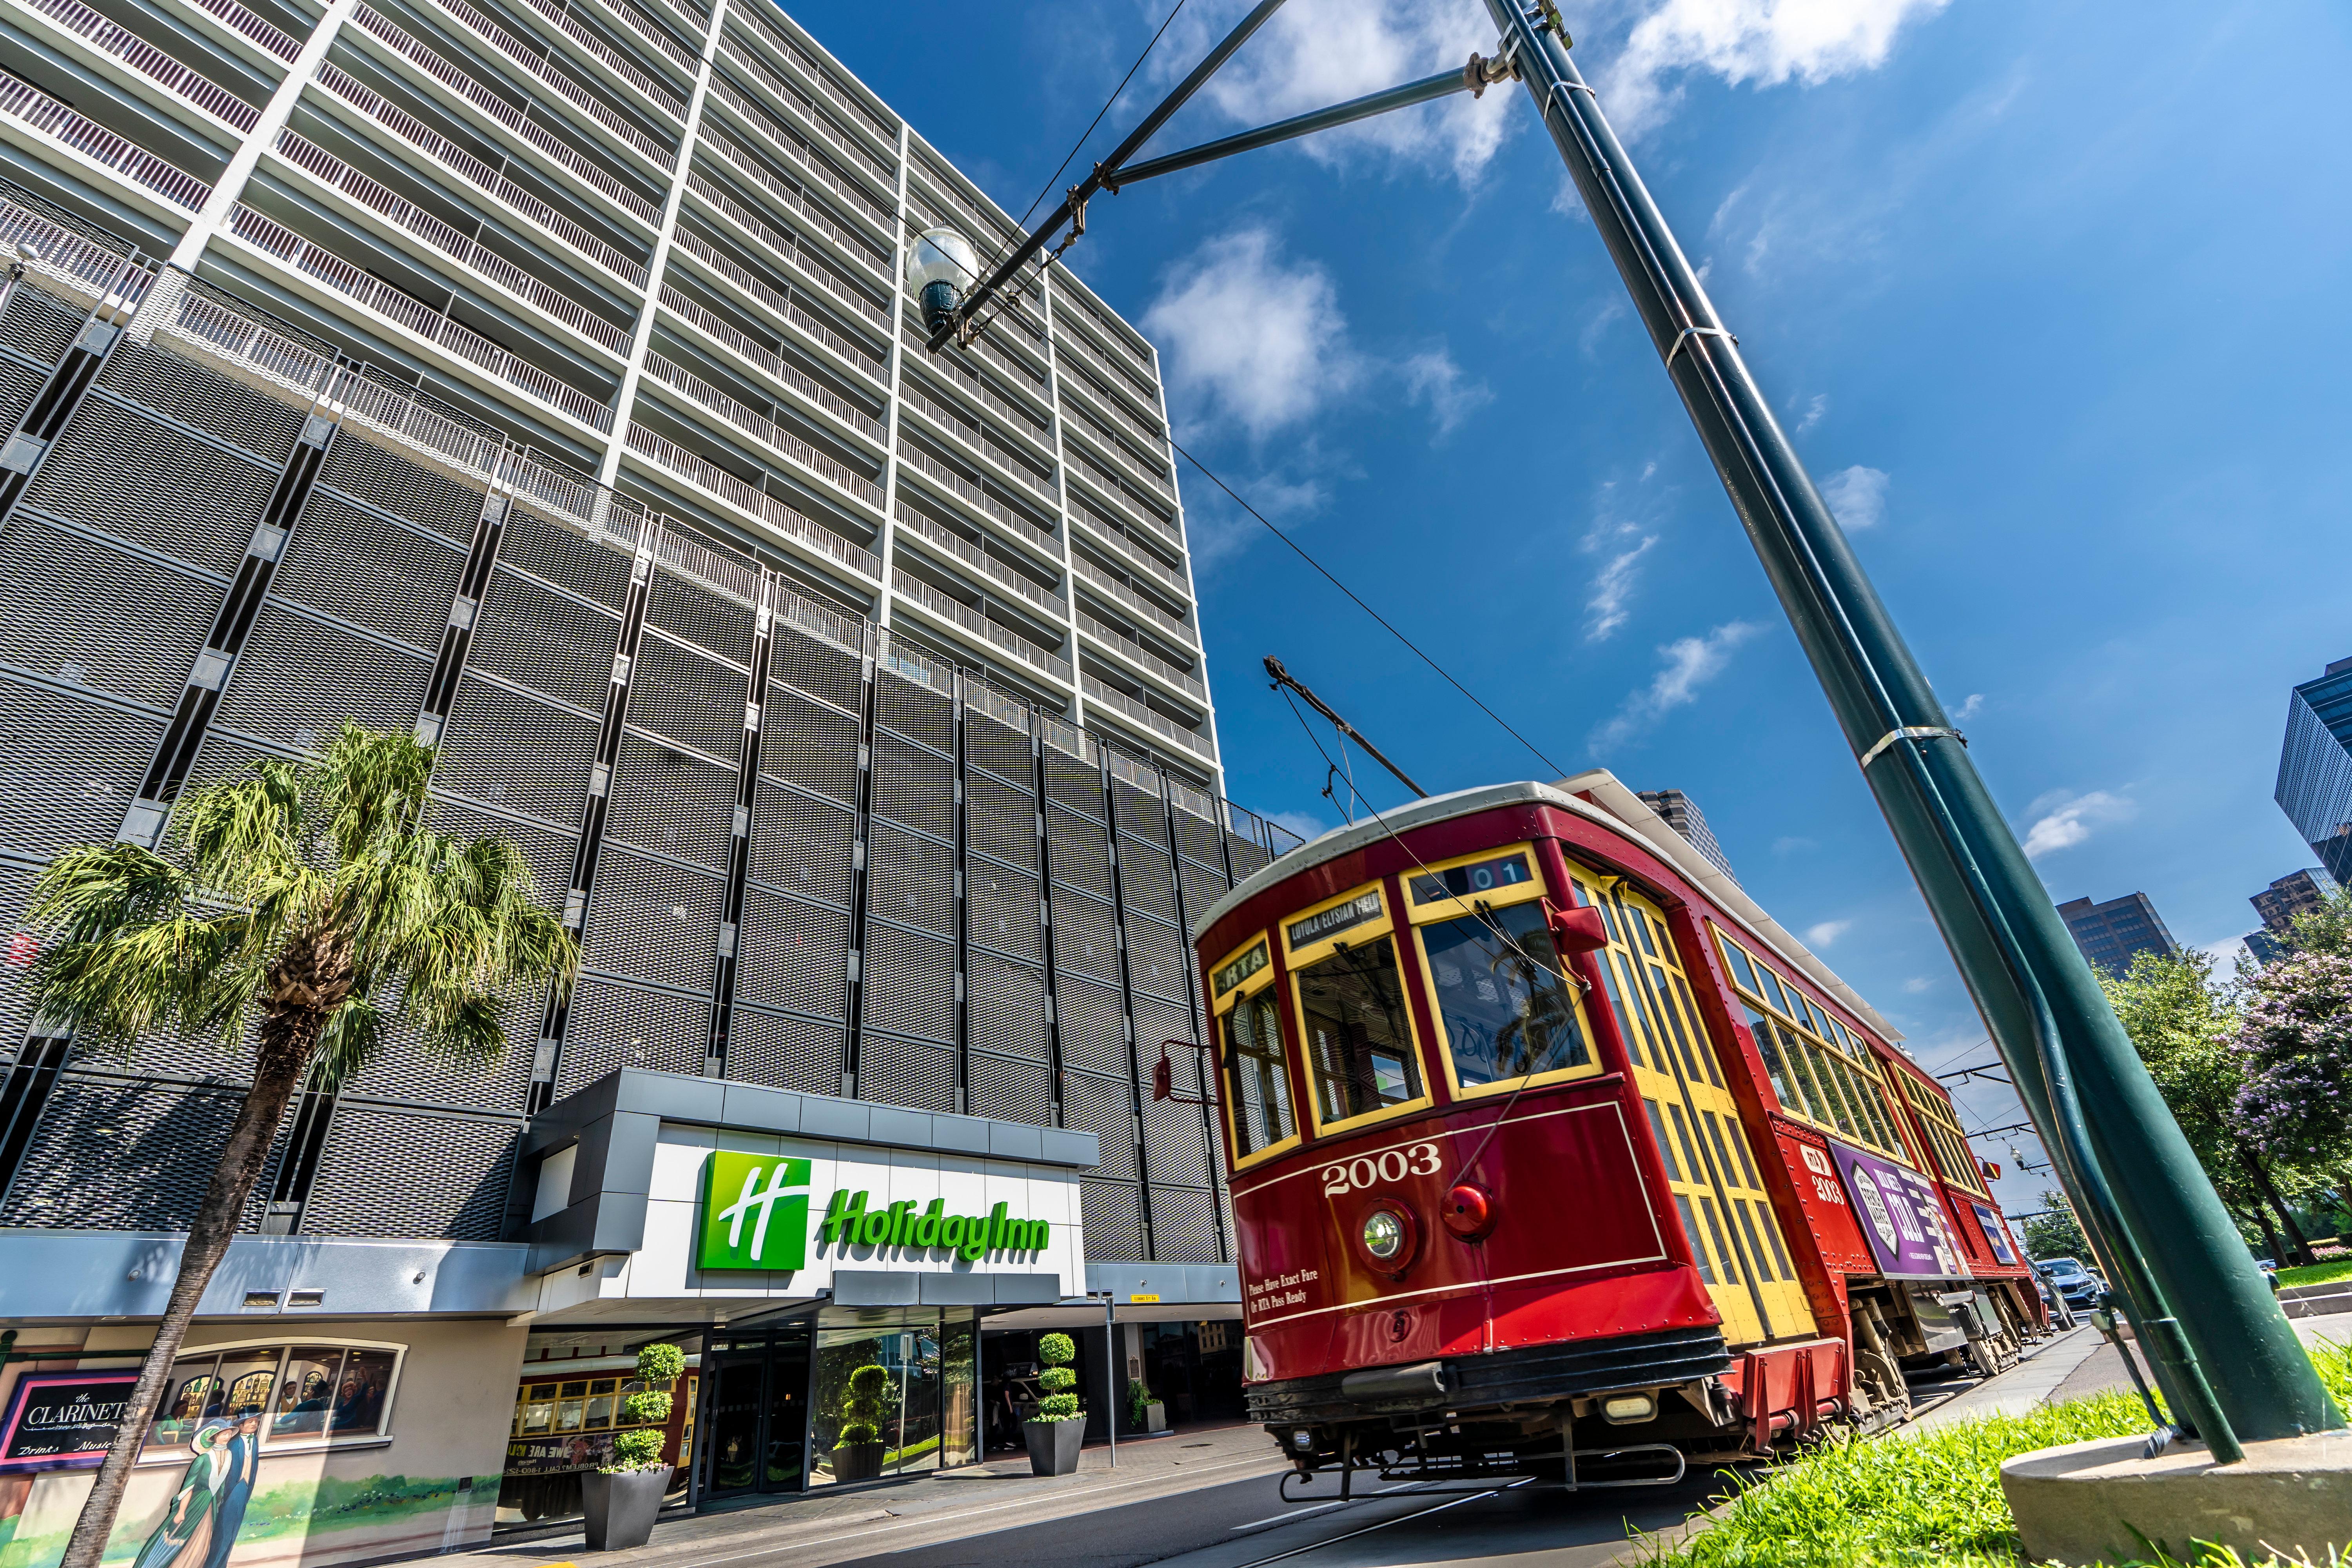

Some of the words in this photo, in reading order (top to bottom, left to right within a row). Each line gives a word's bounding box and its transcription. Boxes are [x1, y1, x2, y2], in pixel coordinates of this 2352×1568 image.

[1225, 947, 1265, 989] RTA
[1321, 1143, 1442, 1198] 2003
[1806, 1151, 1820, 1168] RTA
[1811, 1175, 1844, 1205] 2003
[1860, 1187, 1883, 1208] FRENCH
[1868, 1206, 1888, 1225] MARKET
[1885, 1192, 1925, 1243] COLD
[1264, 1279, 1280, 1291] Have
[1280, 1273, 1300, 1287] Exact
[1301, 1269, 1318, 1282] Fare
[1250, 1301, 1258, 1313] Or
[1258, 1297, 1271, 1311] RTA
[1270, 1296, 1285, 1308] Pass
[1285, 1289, 1307, 1303] Ready
[76, 1393, 90, 1403] the
[28, 1402, 128, 1425] CLARINET
[17, 1446, 60, 1455] Drinks
[73, 1441, 113, 1451] Music
